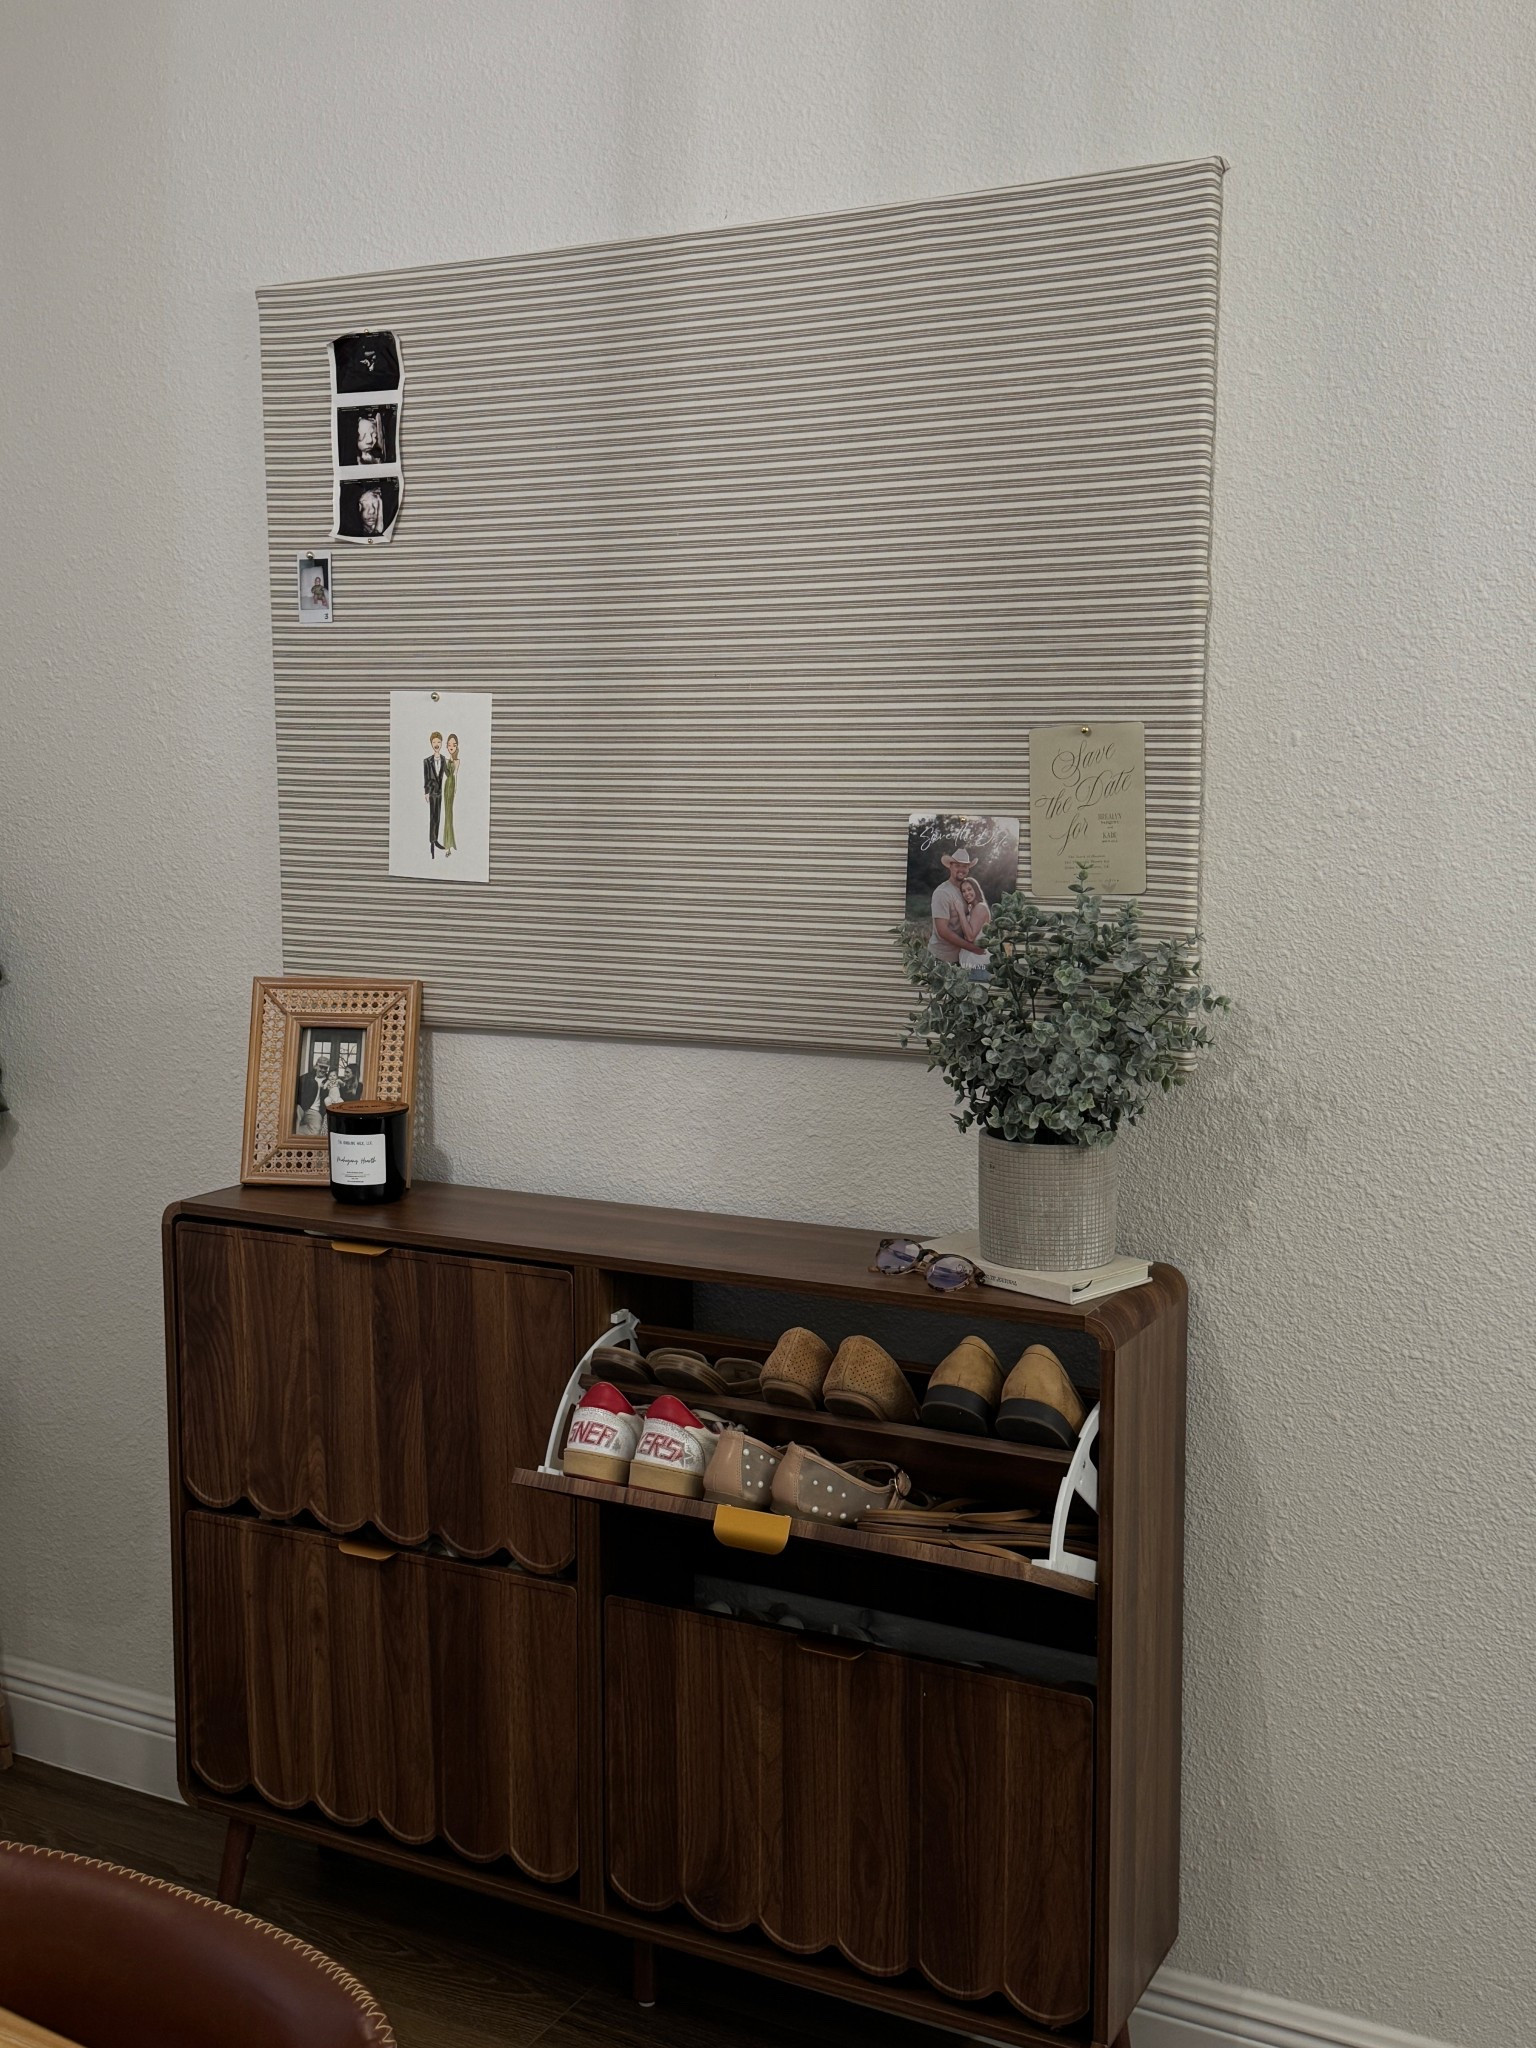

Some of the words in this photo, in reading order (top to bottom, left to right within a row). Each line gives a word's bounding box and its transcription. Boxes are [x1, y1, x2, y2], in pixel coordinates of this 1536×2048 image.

[1052, 740, 1115, 788] Save
[1075, 766, 1136, 810] Date
[637, 1432, 685, 1462] ERS
